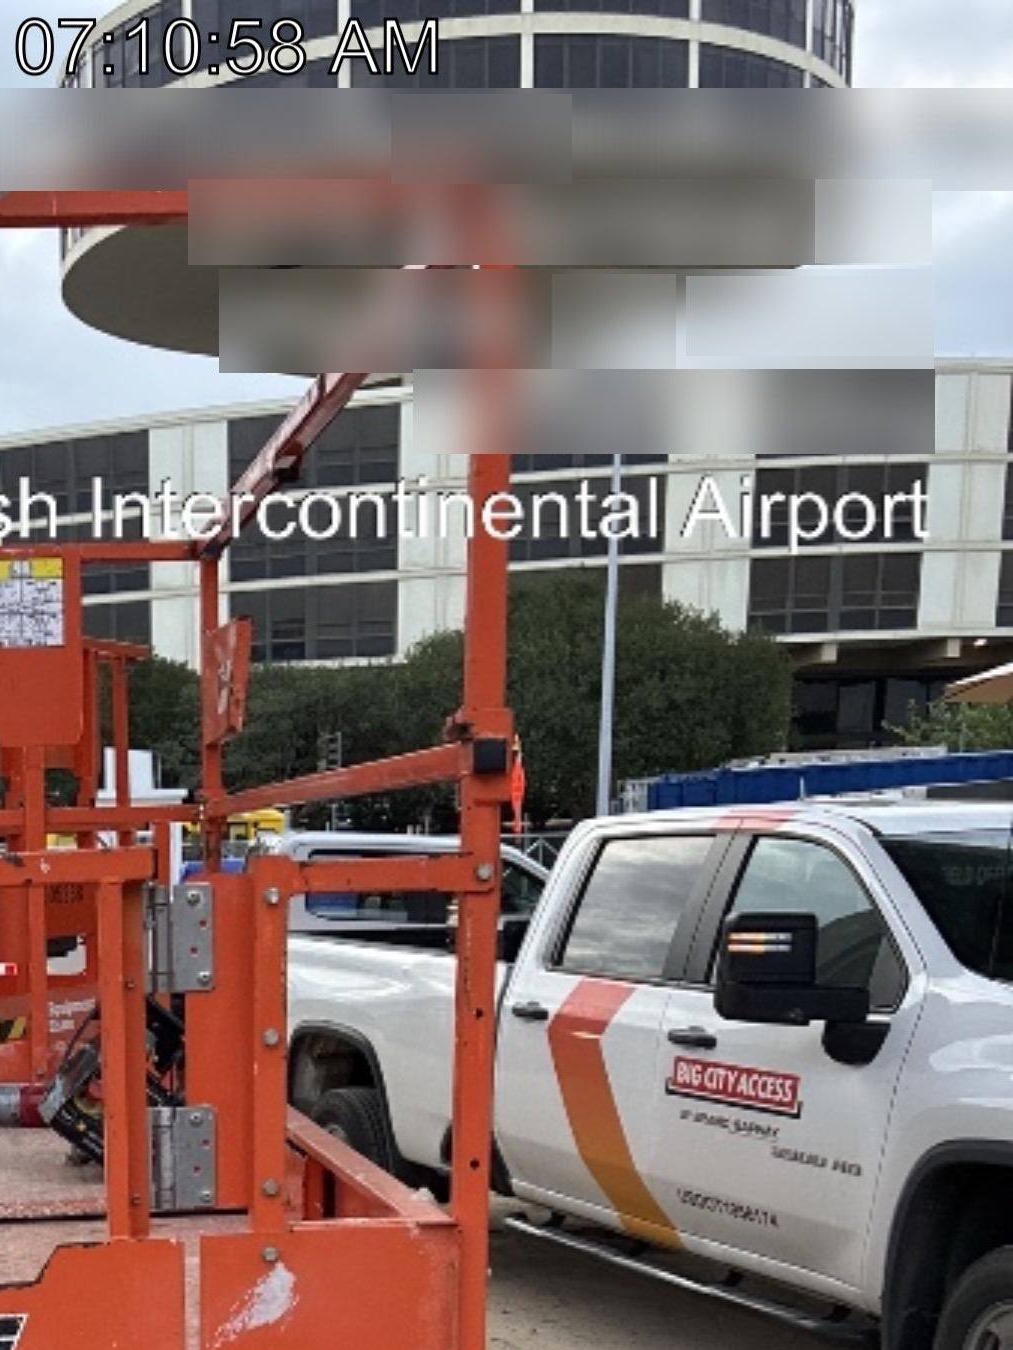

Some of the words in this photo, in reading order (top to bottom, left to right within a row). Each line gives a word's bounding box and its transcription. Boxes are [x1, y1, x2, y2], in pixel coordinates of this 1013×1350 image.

[676, 1061, 702, 1087] BIG
[704, 1066, 738, 1093] CITY
[738, 1073, 793, 1102] ACCESS
